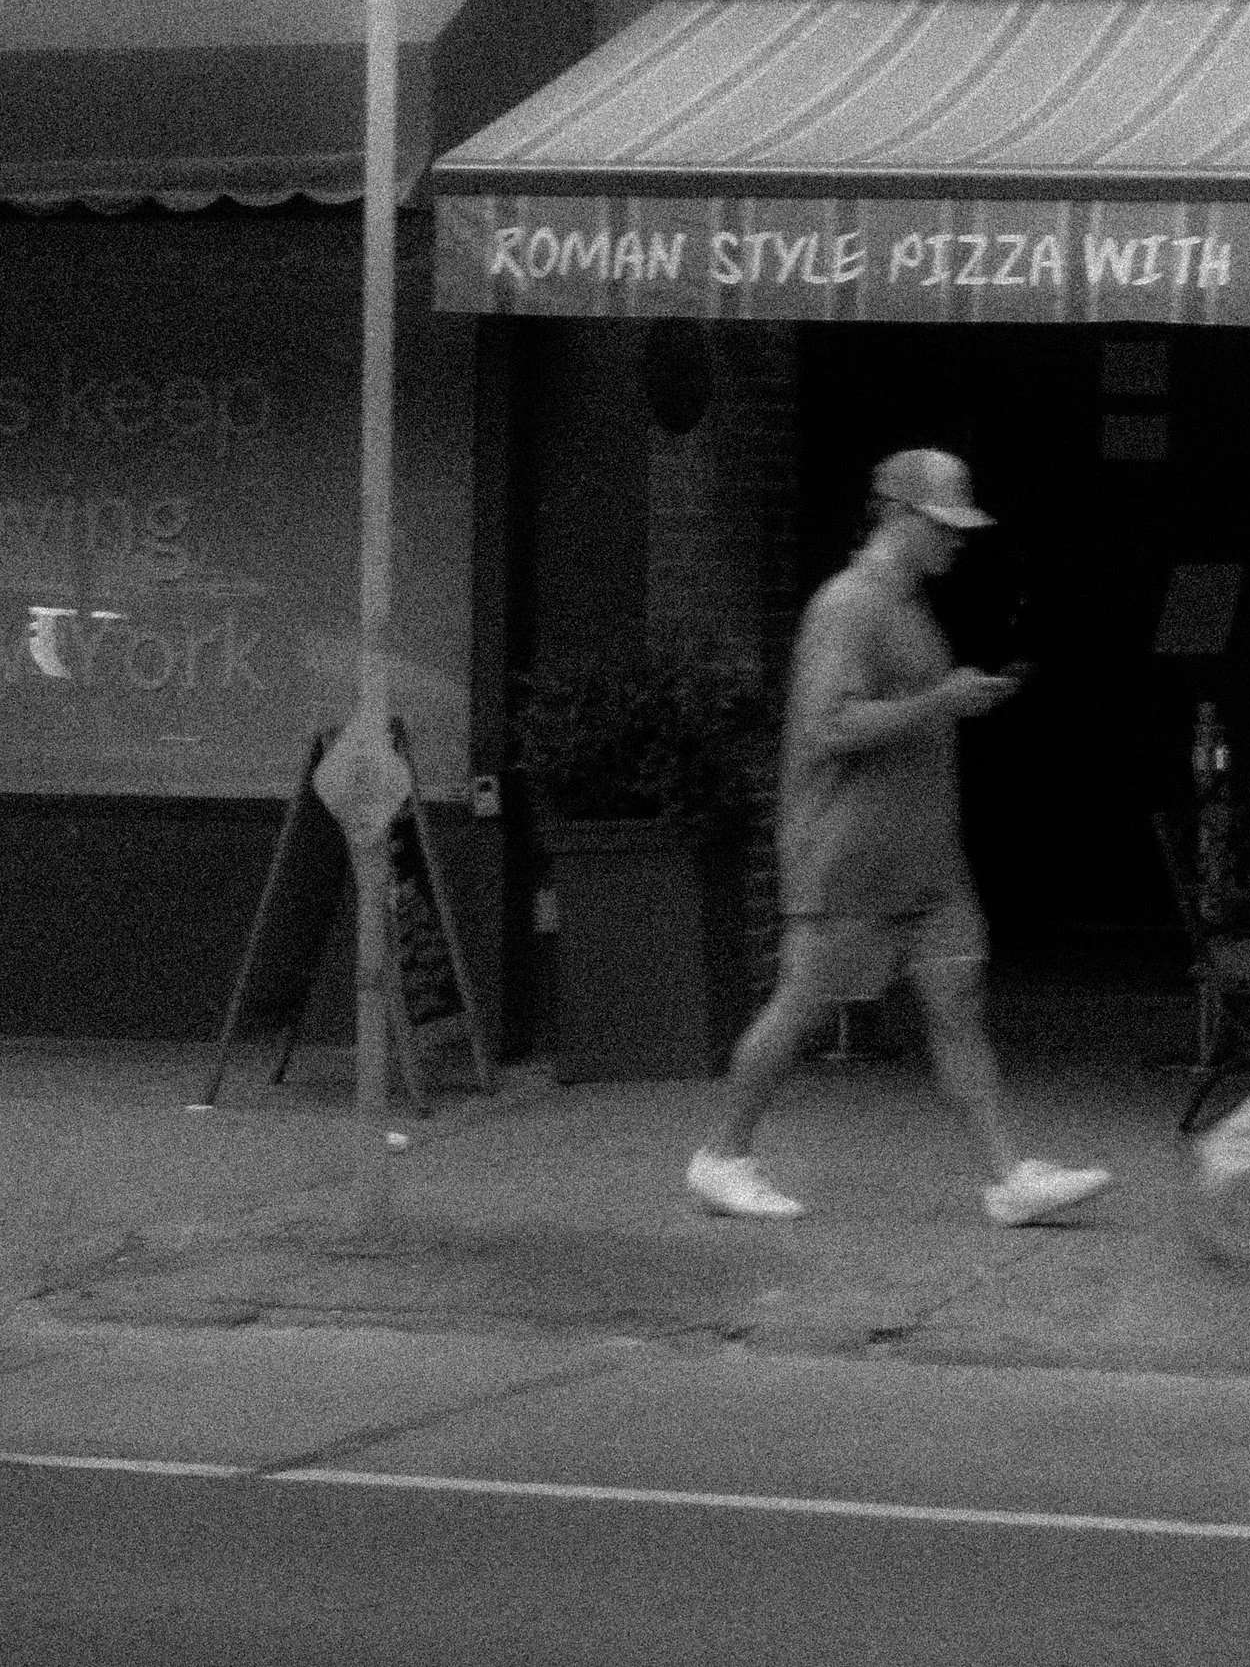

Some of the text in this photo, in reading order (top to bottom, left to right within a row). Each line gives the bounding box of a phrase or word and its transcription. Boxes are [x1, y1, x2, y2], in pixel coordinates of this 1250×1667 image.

[490, 226, 687, 285] ROMAN
[711, 228, 868, 286] STYLE
[889, 231, 1065, 288] PIZZA
[1083, 234, 1233, 291] WITH
[60, 355, 272, 458] keep
